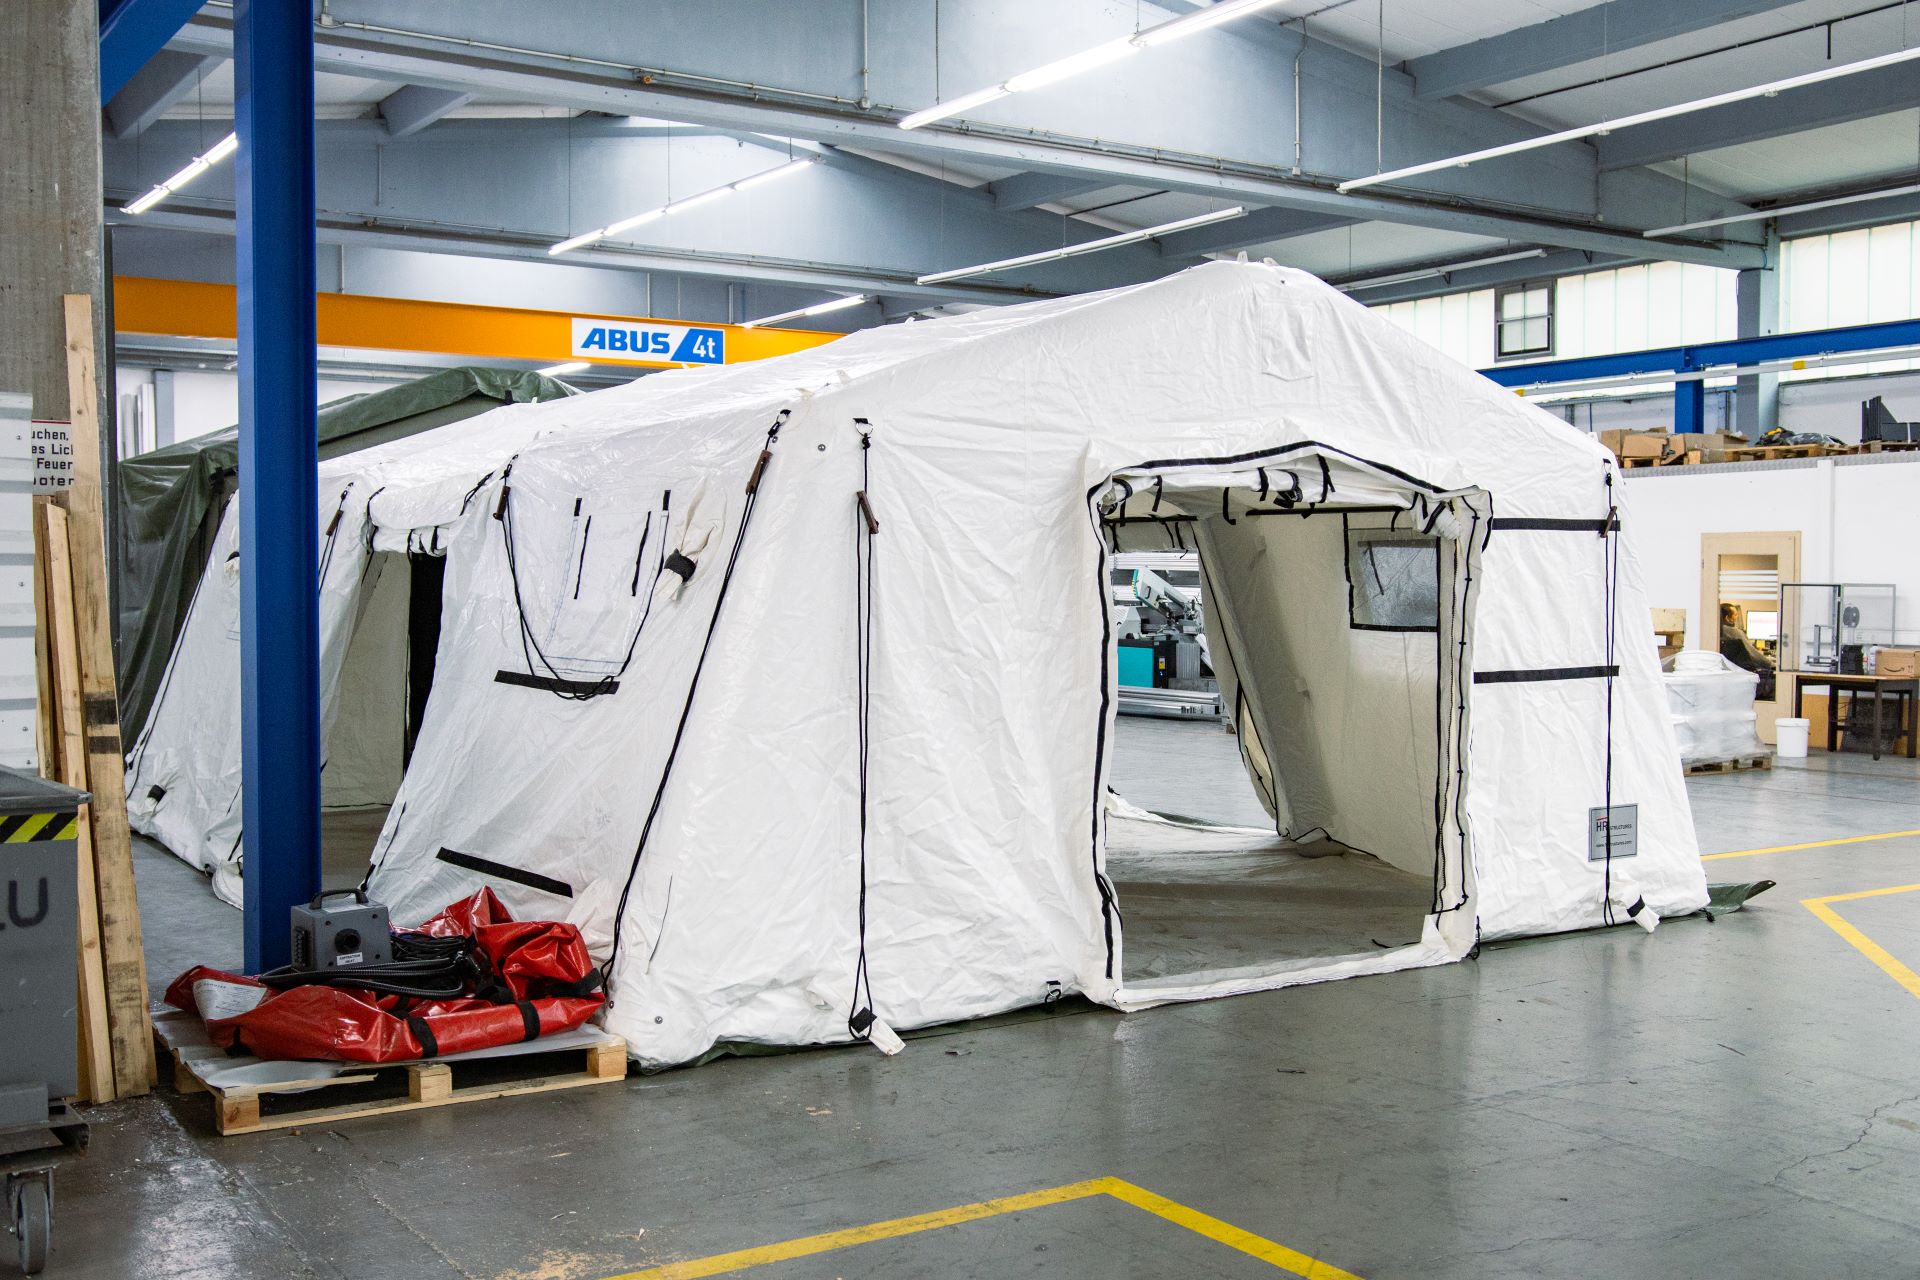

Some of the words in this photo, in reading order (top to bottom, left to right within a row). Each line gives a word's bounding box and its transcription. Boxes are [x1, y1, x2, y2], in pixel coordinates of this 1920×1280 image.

[580, 327, 670, 354] ABUS
[692, 335, 716, 358] 4t
[37, 457, 73, 470] Feuer
